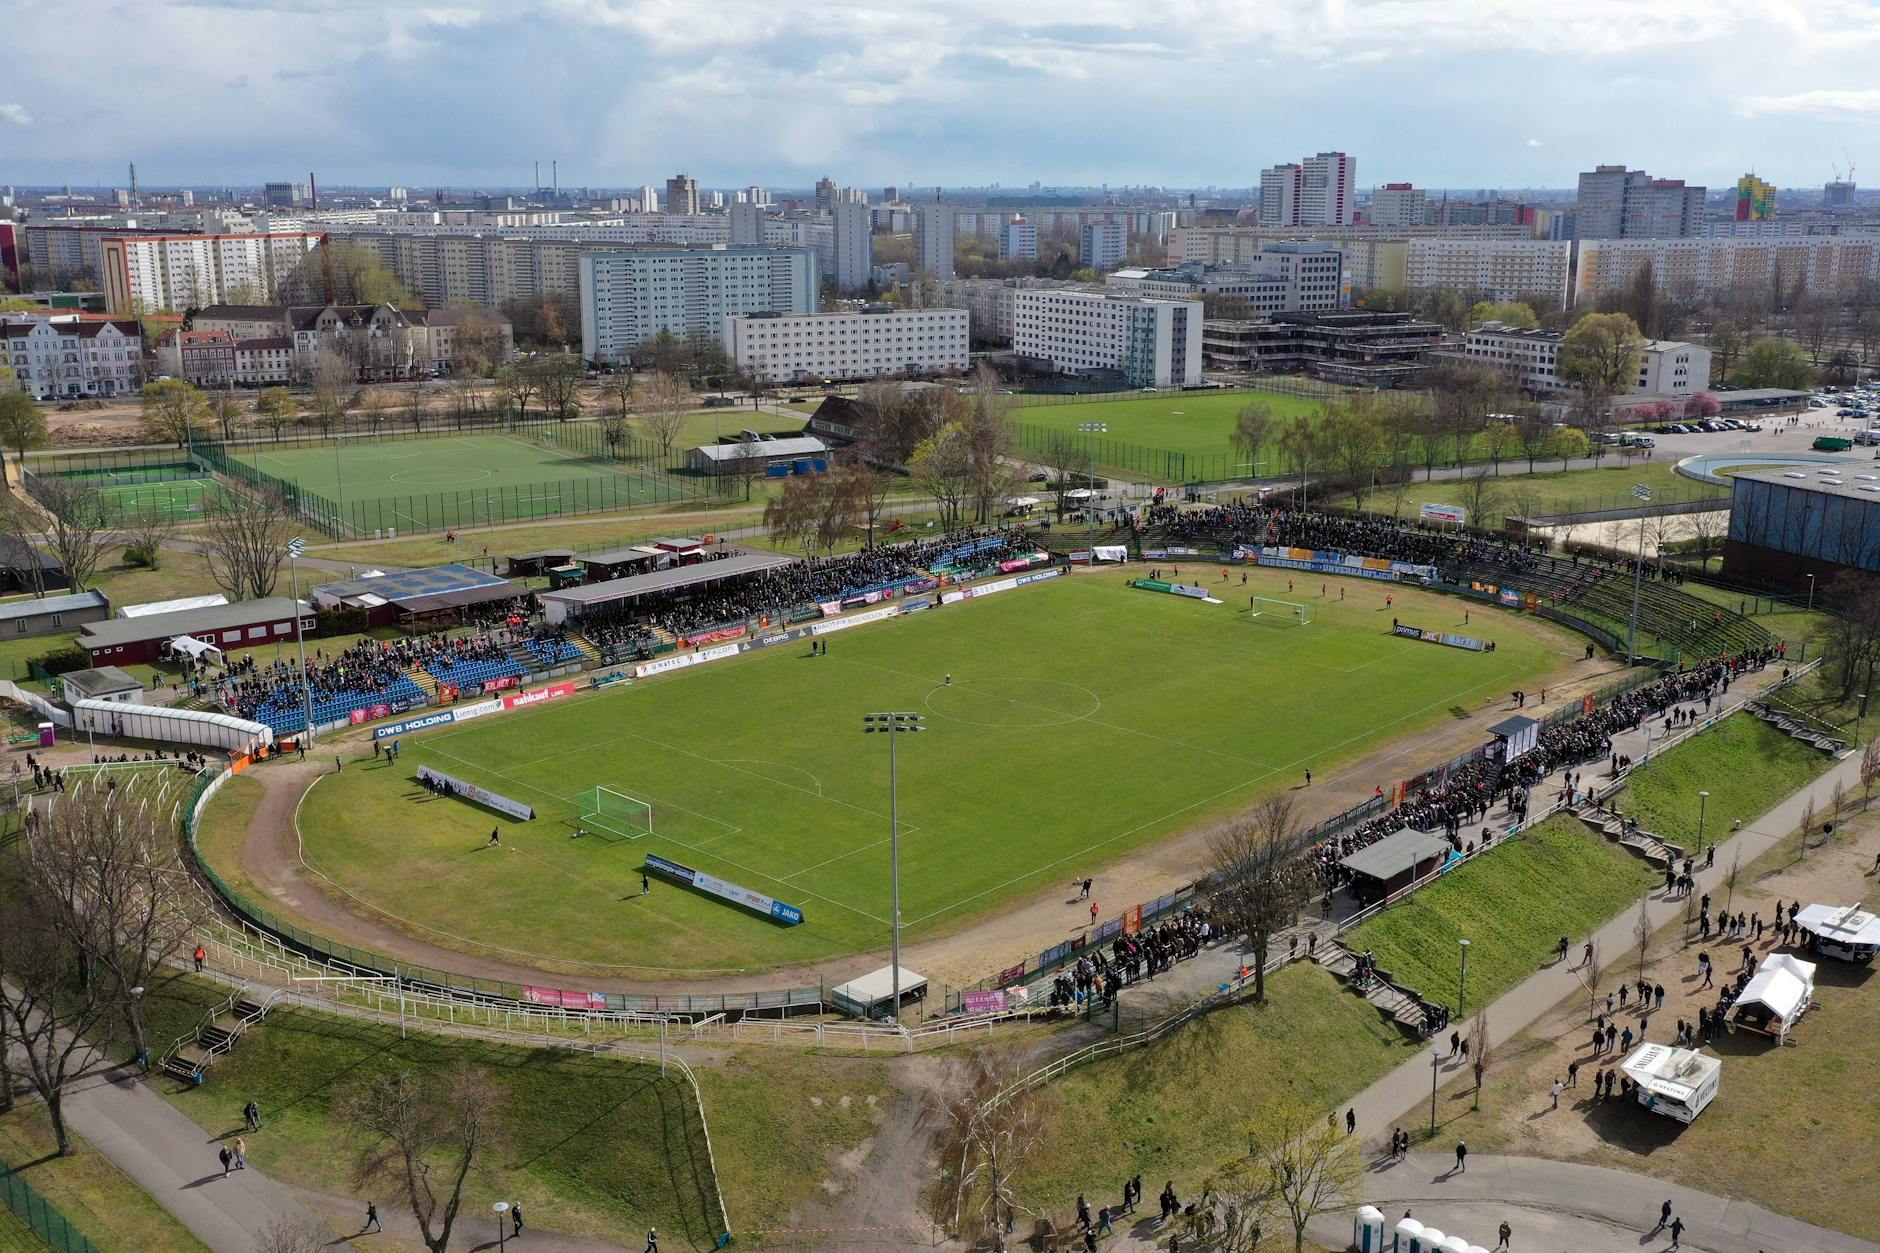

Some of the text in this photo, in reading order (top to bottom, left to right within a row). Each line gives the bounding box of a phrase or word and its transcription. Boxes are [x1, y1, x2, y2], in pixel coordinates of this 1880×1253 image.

[513, 689, 549, 706] nahkauf
[378, 725, 403, 737] DWB
[405, 713, 452, 731] HOLDING
[782, 908, 799, 921] JAKO
